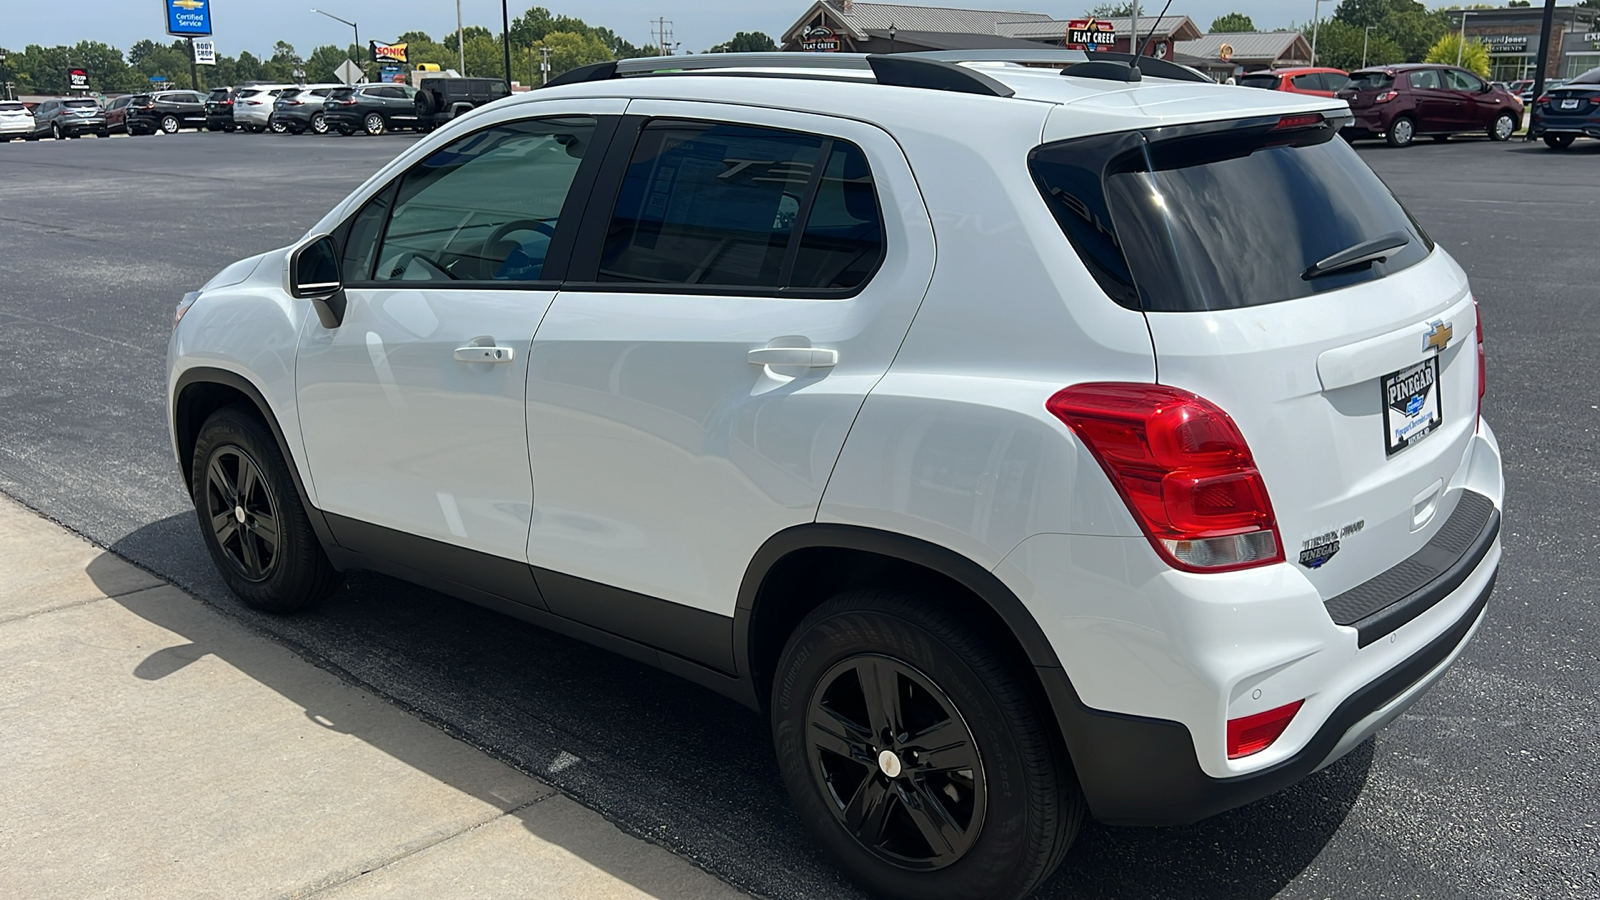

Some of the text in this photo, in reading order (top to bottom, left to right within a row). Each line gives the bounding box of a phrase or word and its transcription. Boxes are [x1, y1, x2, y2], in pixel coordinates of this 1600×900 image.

[176, 13, 204, 21] Certified
[1073, 31, 1115, 44] FLAT CREEK
[376, 46, 405, 57] SONIC
[1389, 366, 1433, 405] PINEGAR
[1300, 541, 1340, 563] PINEGAR
[780, 646, 810, 710] Continental
